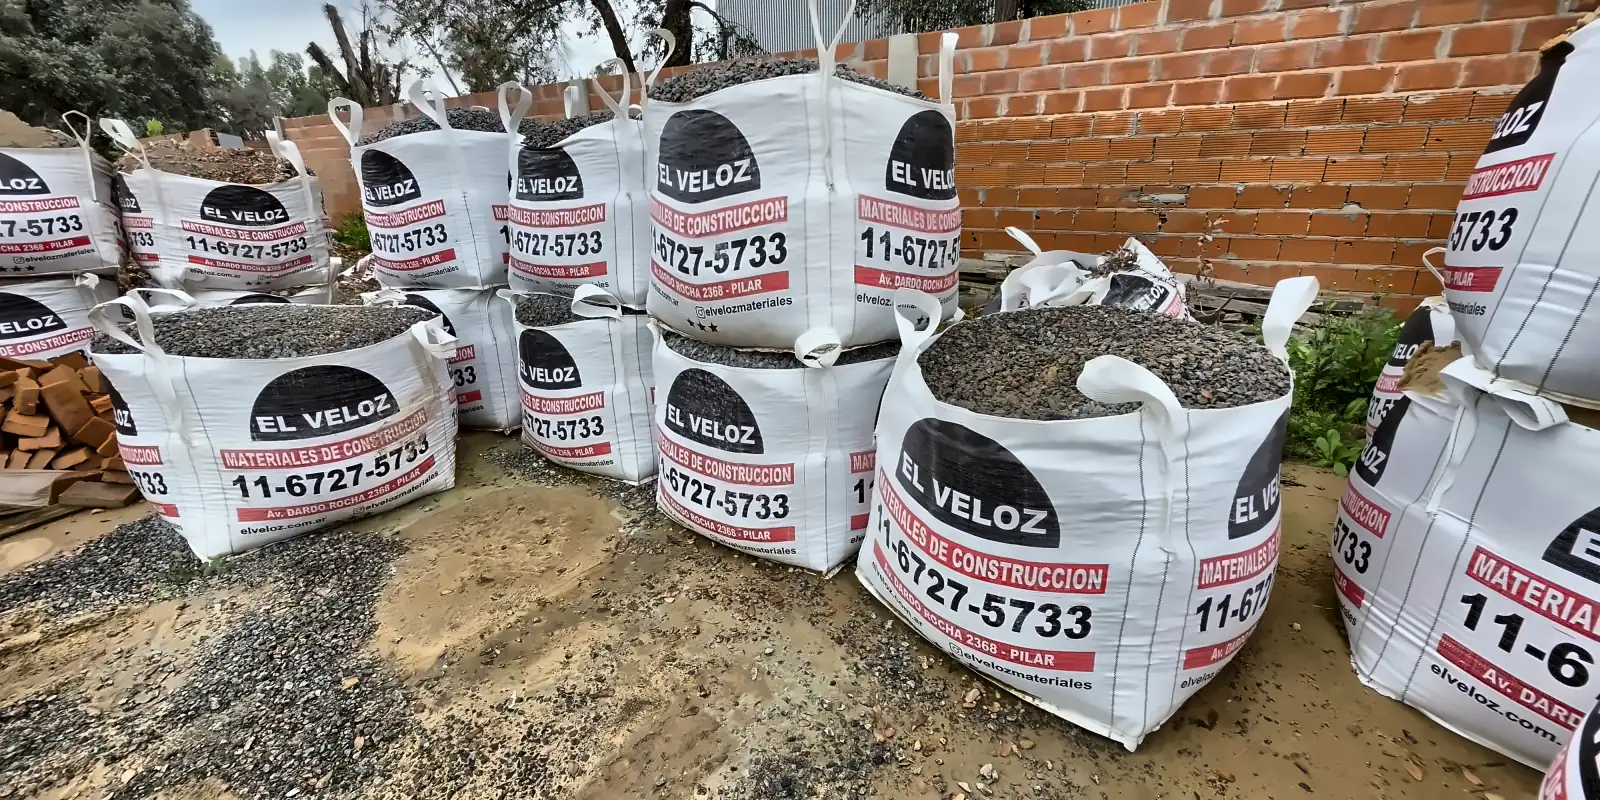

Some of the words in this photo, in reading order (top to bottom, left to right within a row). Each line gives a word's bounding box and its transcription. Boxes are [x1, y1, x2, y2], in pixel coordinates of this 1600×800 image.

[518, 178, 528, 193] EL
[529, 176, 578, 194] VELOZ
[659, 163, 672, 186] EL
[677, 158, 751, 192] VELOZ
[892, 160, 916, 186] EL
[376, 179, 415, 200] VELOZ
[0, 214, 83, 238] 7-5733
[203, 206, 227, 219] EL
[230, 208, 285, 222] VELOZ
[390, 201, 444, 226] CONSTRUCCION
[532, 210, 539, 225] DE
[541, 205, 604, 225] CONSTRUCCION
[674, 213, 684, 232] DE
[687, 200, 785, 235] CONSTRUCCION
[861, 198, 924, 229] MATERIALES
[927, 213, 937, 230] DE
[182, 221, 237, 239] MATERIALES
[238, 231, 251, 240] DE
[252, 222, 306, 241] CONSTRUCCION
[23, 244, 44, 252] 2368
[51, 239, 74, 249] PILAR
[25, 248, 96, 263] elvelozmateriales
[186, 236, 308, 260] 11-6727-5733
[216, 261, 240, 270] DARDO
[422, 254, 440, 265] PILAR
[570, 266, 589, 276] PILAR
[676, 281, 701, 299] ROCHA
[702, 285, 723, 298] 2368
[732, 279, 762, 294] PILAR
[879, 274, 892, 286] Av.
[895, 275, 920, 289] DARDO
[923, 279, 943, 290] ROCHA
[1453, 272, 1474, 286] PILAR
[706, 296, 792, 317] elvelozmateriales
[17, 328, 94, 354] CONSTRUCCION
[529, 366, 575, 383] VELOZ
[256, 416, 297, 432] EL
[302, 393, 391, 429] VELOZ
[533, 397, 540, 411] DE
[542, 393, 602, 413] CONSTRUCCION
[667, 403, 684, 427] EL
[689, 413, 756, 445] VELOZ
[224, 449, 319, 467] MATERIALES
[321, 445, 341, 461] DE
[343, 410, 427, 456] CONSTRUCCION
[575, 447, 594, 456] PILAR
[232, 432, 429, 498] 11-6727-5733
[692, 453, 702, 471] DE
[705, 459, 791, 483] CONSTRUCCION
[267, 510, 284, 519] Av.
[287, 503, 326, 517] DARDO
[329, 495, 365, 509] ROCHA
[368, 486, 390, 498] 2368
[396, 468, 421, 486] PILAR
[365, 471, 439, 510] elvelozmateriales
[902, 451, 924, 493] EL
[932, 477, 1048, 535] VELOZ
[1235, 496, 1259, 524] EL
[240, 517, 327, 535] elveloz.com.ar
[690, 510, 716, 531] ROCHA
[717, 523, 736, 537] 2368
[743, 530, 771, 540] PILAR
[879, 469, 927, 547] MATERIALES
[929, 535, 948, 562] DE
[952, 547, 1103, 590] CONSTRUCCION
[877, 503, 1093, 640] 11-6727-5733
[1201, 550, 1267, 585] MATERIALES
[1473, 553, 1600, 637] MATERIA
[893, 578, 921, 611] DARDO
[924, 608, 962, 640] ROCHA
[966, 634, 997, 654] 2368
[1010, 649, 1055, 666] PILAR
[1211, 647, 1223, 661] Av.
[963, 652, 1092, 690] elvelozmateriales
[1482, 668, 1512, 694] Av.
